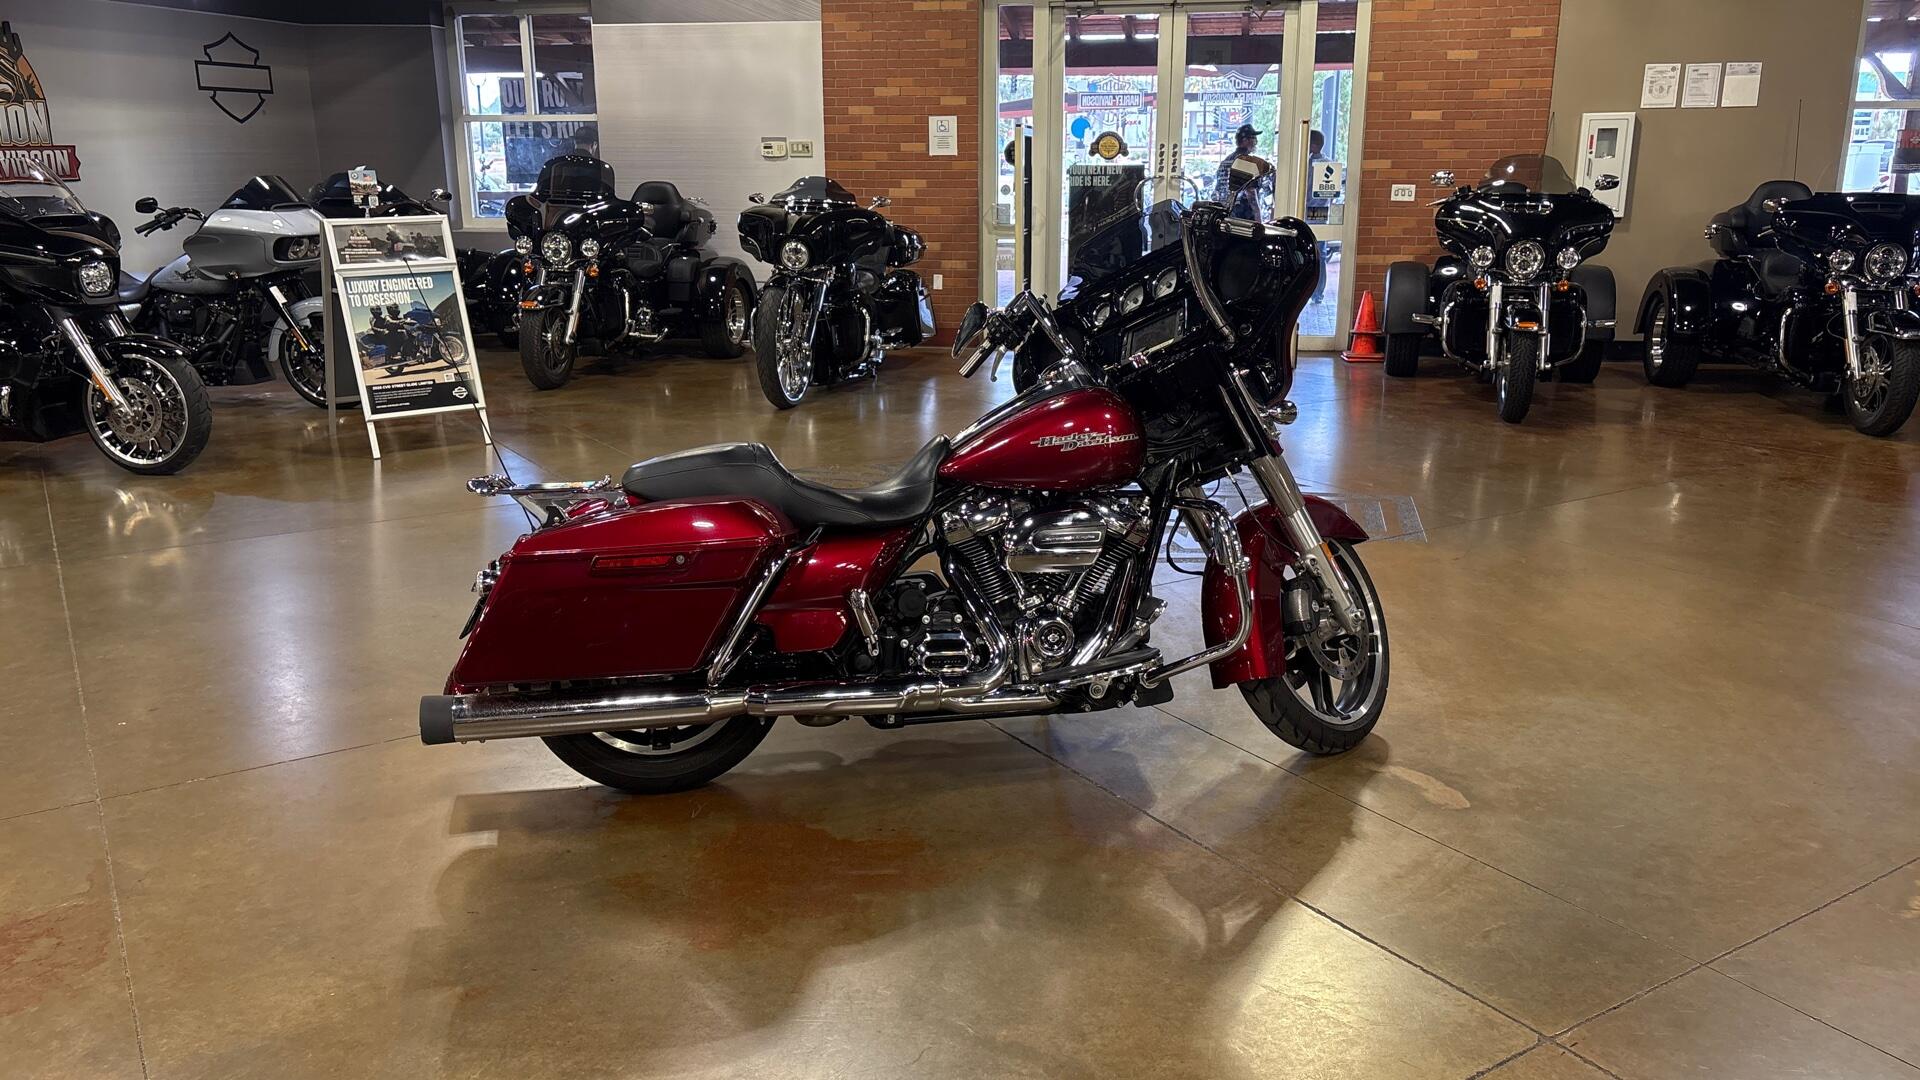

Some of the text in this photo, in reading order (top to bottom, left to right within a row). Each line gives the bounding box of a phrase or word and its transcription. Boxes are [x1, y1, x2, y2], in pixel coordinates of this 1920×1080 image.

[1088, 165, 1105, 175] NEXT
[1106, 165, 1123, 175] NEW
[1085, 175, 1092, 187] IS
[1093, 175, 1112, 187] HERE.
[346, 276, 434, 293] LUXURY ENGINEERED
[349, 294, 361, 308] TO
